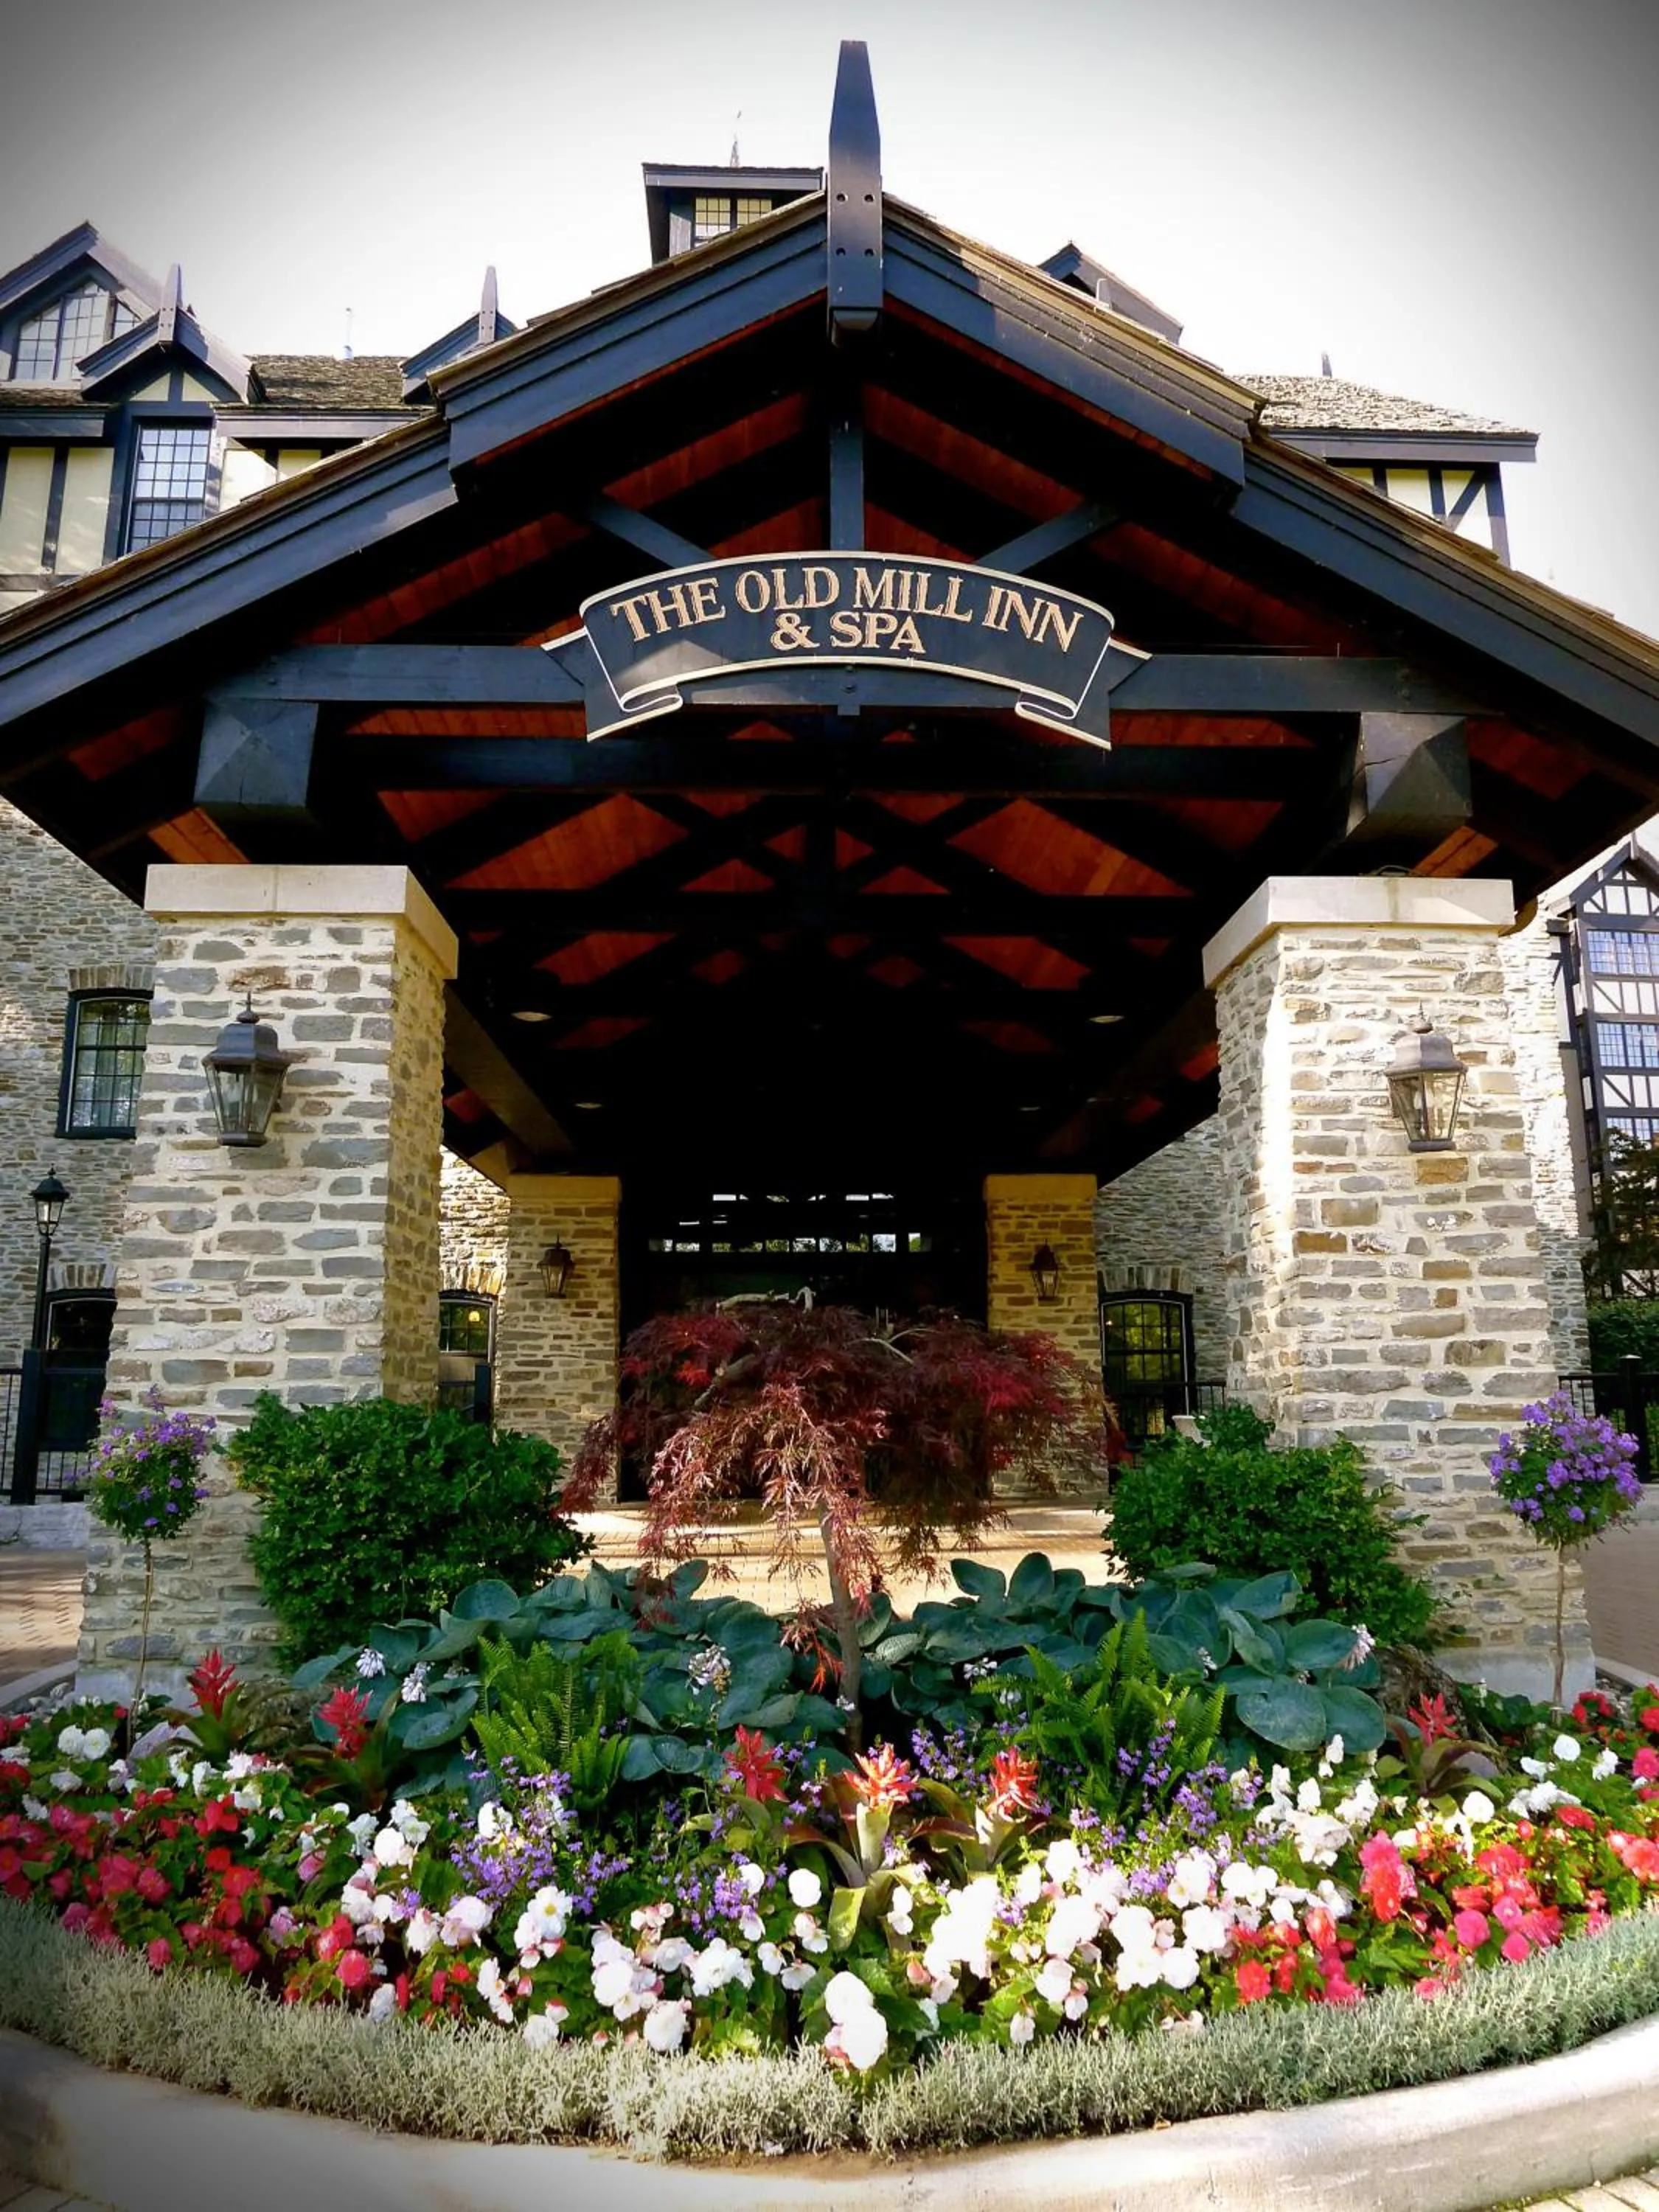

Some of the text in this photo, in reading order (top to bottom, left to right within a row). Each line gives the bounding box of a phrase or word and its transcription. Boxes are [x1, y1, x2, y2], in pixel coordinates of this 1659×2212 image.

[612, 567, 1084, 653] THE OLD MILL INN
[771, 612, 925, 653] & SPA
